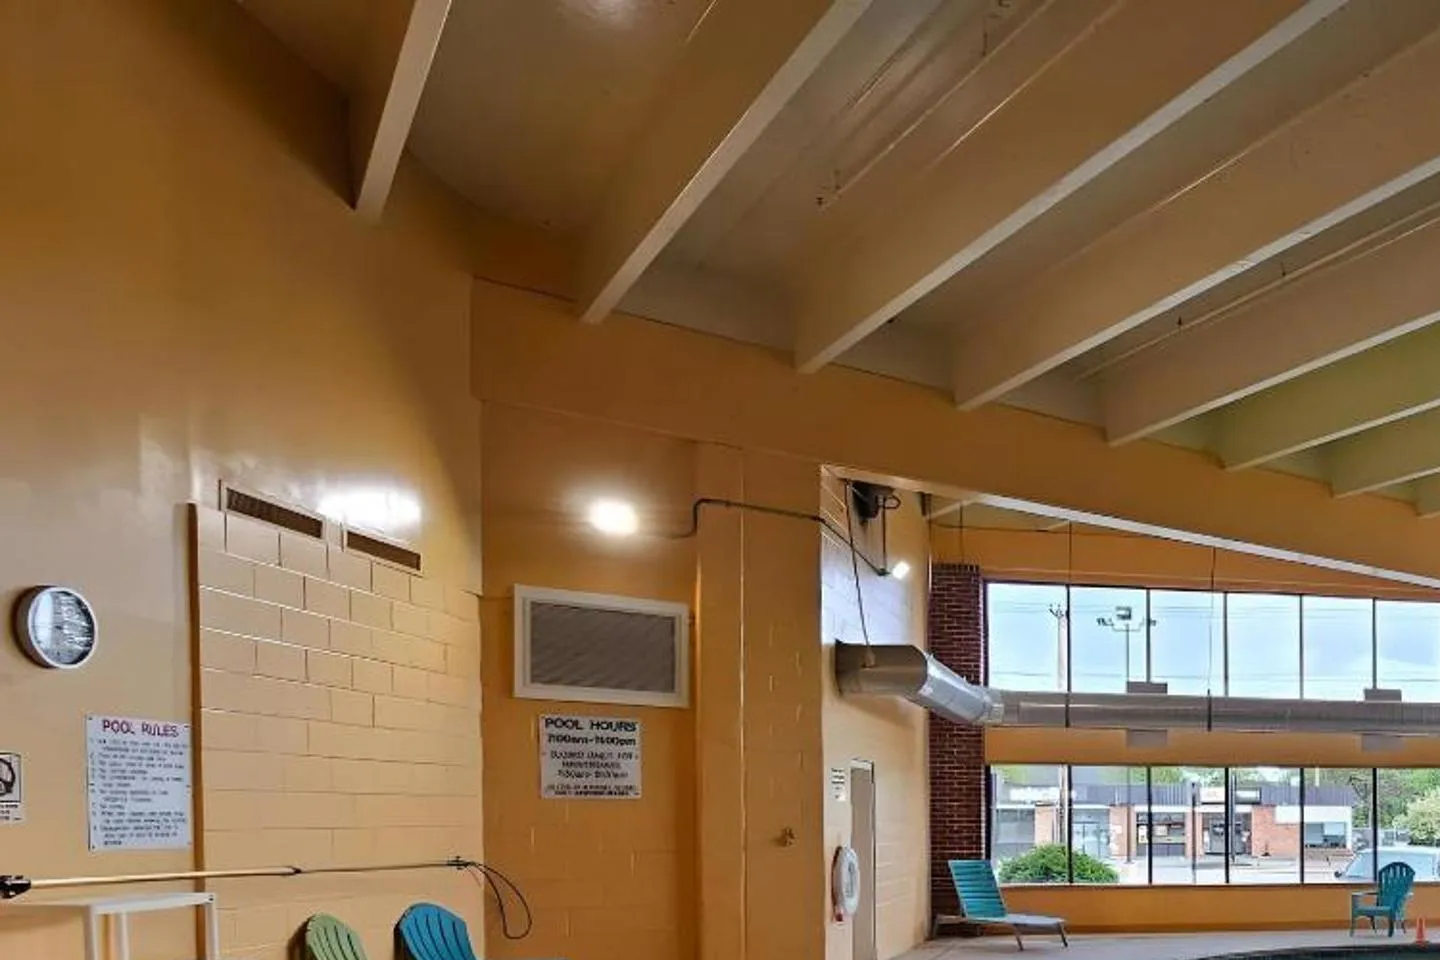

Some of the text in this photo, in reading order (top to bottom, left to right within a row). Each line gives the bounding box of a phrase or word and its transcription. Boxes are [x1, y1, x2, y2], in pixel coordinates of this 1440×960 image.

[103, 719, 179, 738] POOL RULES
[545, 718, 637, 732] POOL HOURS
